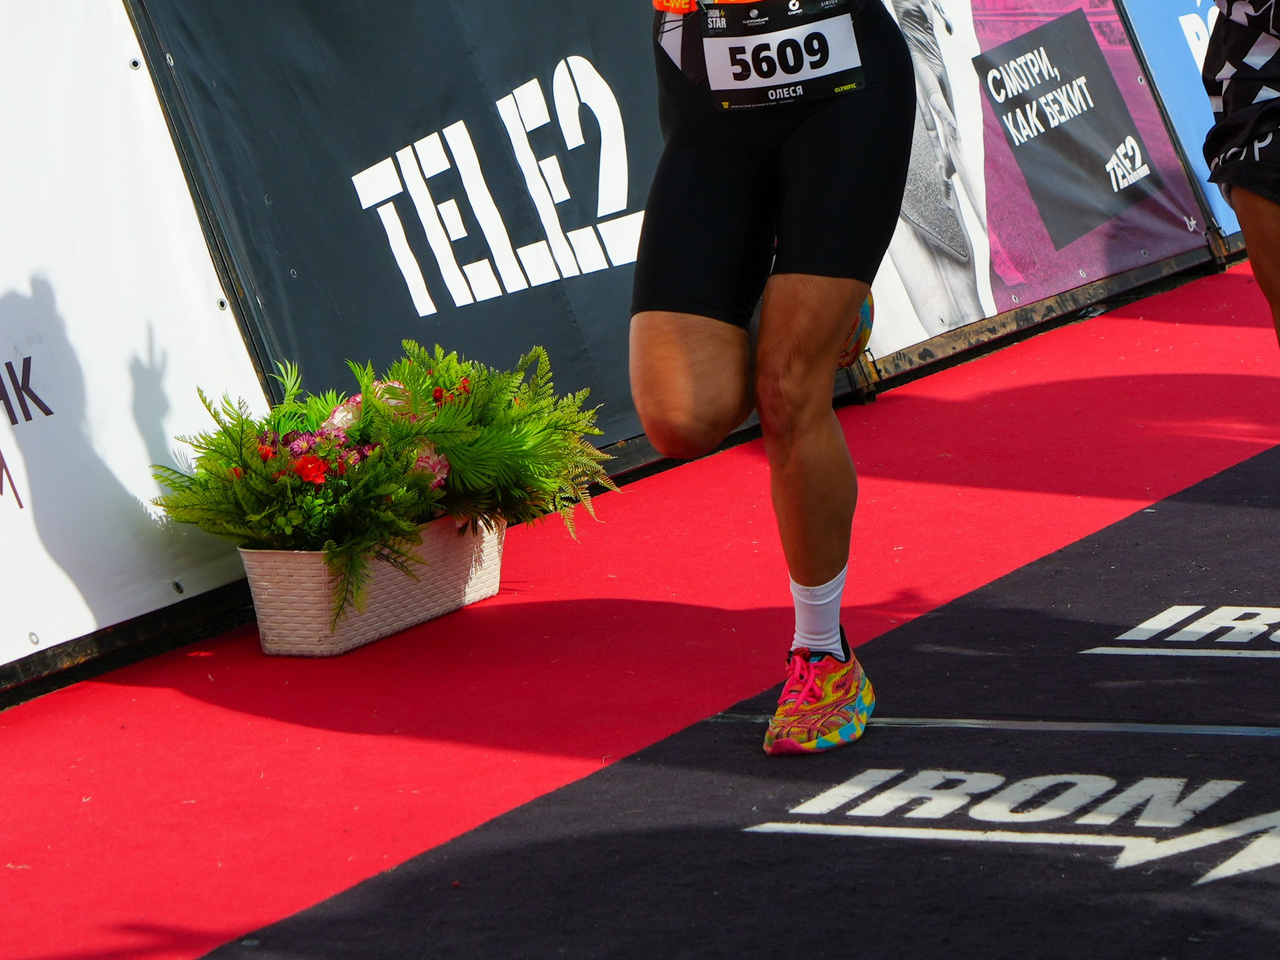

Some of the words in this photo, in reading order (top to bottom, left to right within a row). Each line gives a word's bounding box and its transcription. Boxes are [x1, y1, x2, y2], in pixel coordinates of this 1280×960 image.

[707, 17, 727, 29] STAR
[728, 31, 830, 82] 5609
[986, 46, 1061, 104] СМОТРИ,
[767, 85, 804, 100] ОЛЕСЯ
[834, 82, 857, 93] OLYMPIC
[1002, 100, 1046, 147] КАК
[1038, 75, 1096, 129] БЕЖИТ
[351, 54, 646, 317] TELE2
[788, 768, 1245, 827] IRON
